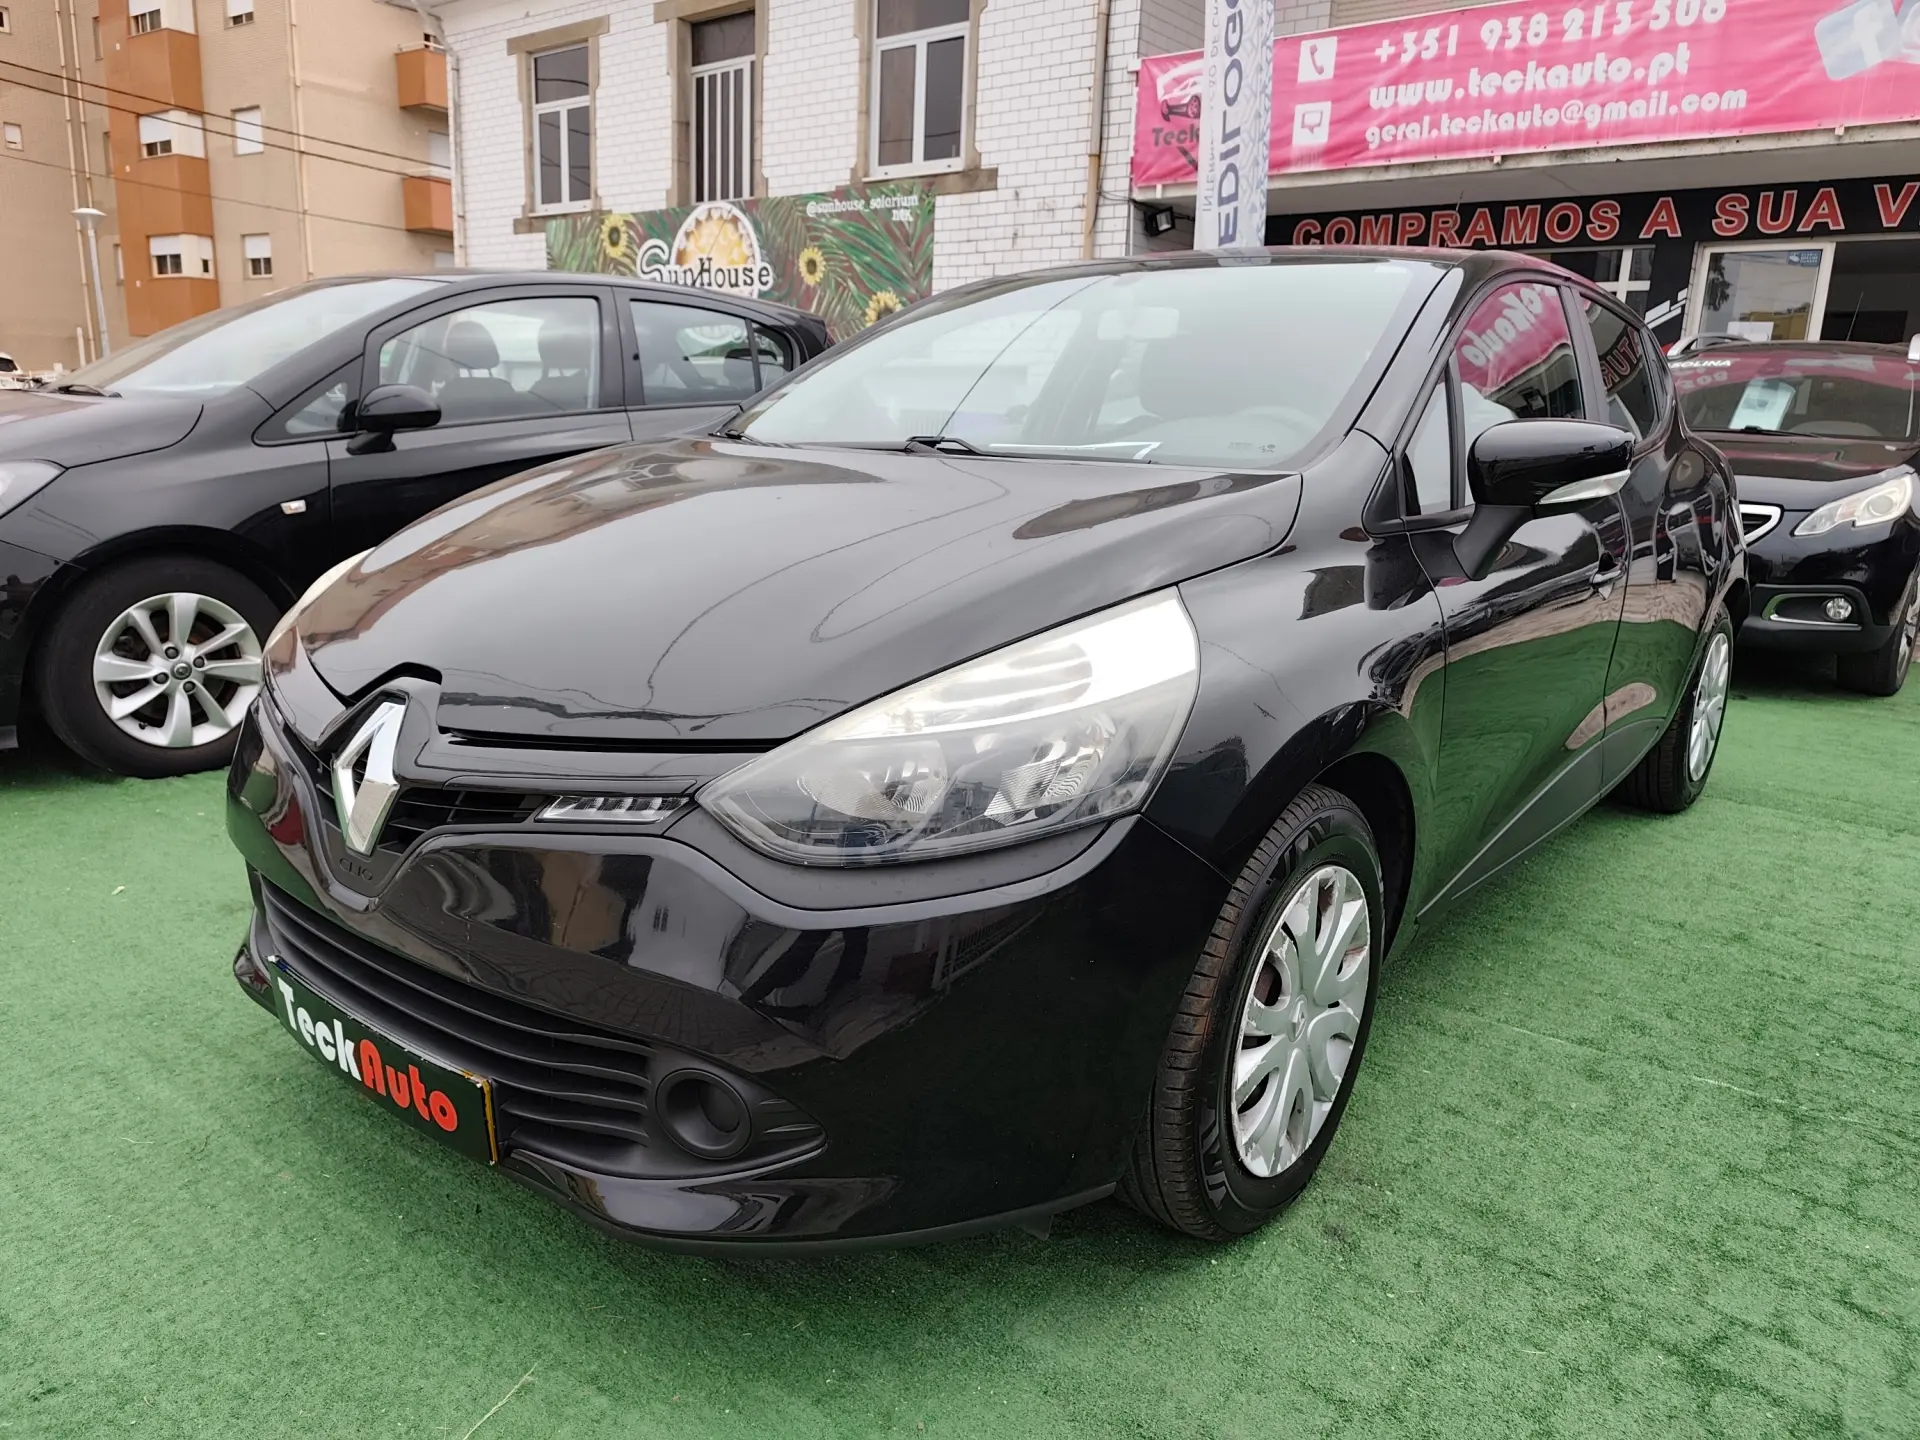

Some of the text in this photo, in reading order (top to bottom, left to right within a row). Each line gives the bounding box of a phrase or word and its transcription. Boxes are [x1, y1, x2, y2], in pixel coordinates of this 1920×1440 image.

[1375, 25, 1459, 64] +351
[1480, 12, 1549, 51] 938
[1562, 1, 1634, 41] 213
[1369, 42, 1690, 109] www.teckauto.pt
[1365, 89, 1748, 150] geral.teckauto@gmail.com
[1293, 182, 1920, 248] COMPRAMOS A SUA V
[277, 977, 458, 1132] TeckAuto
